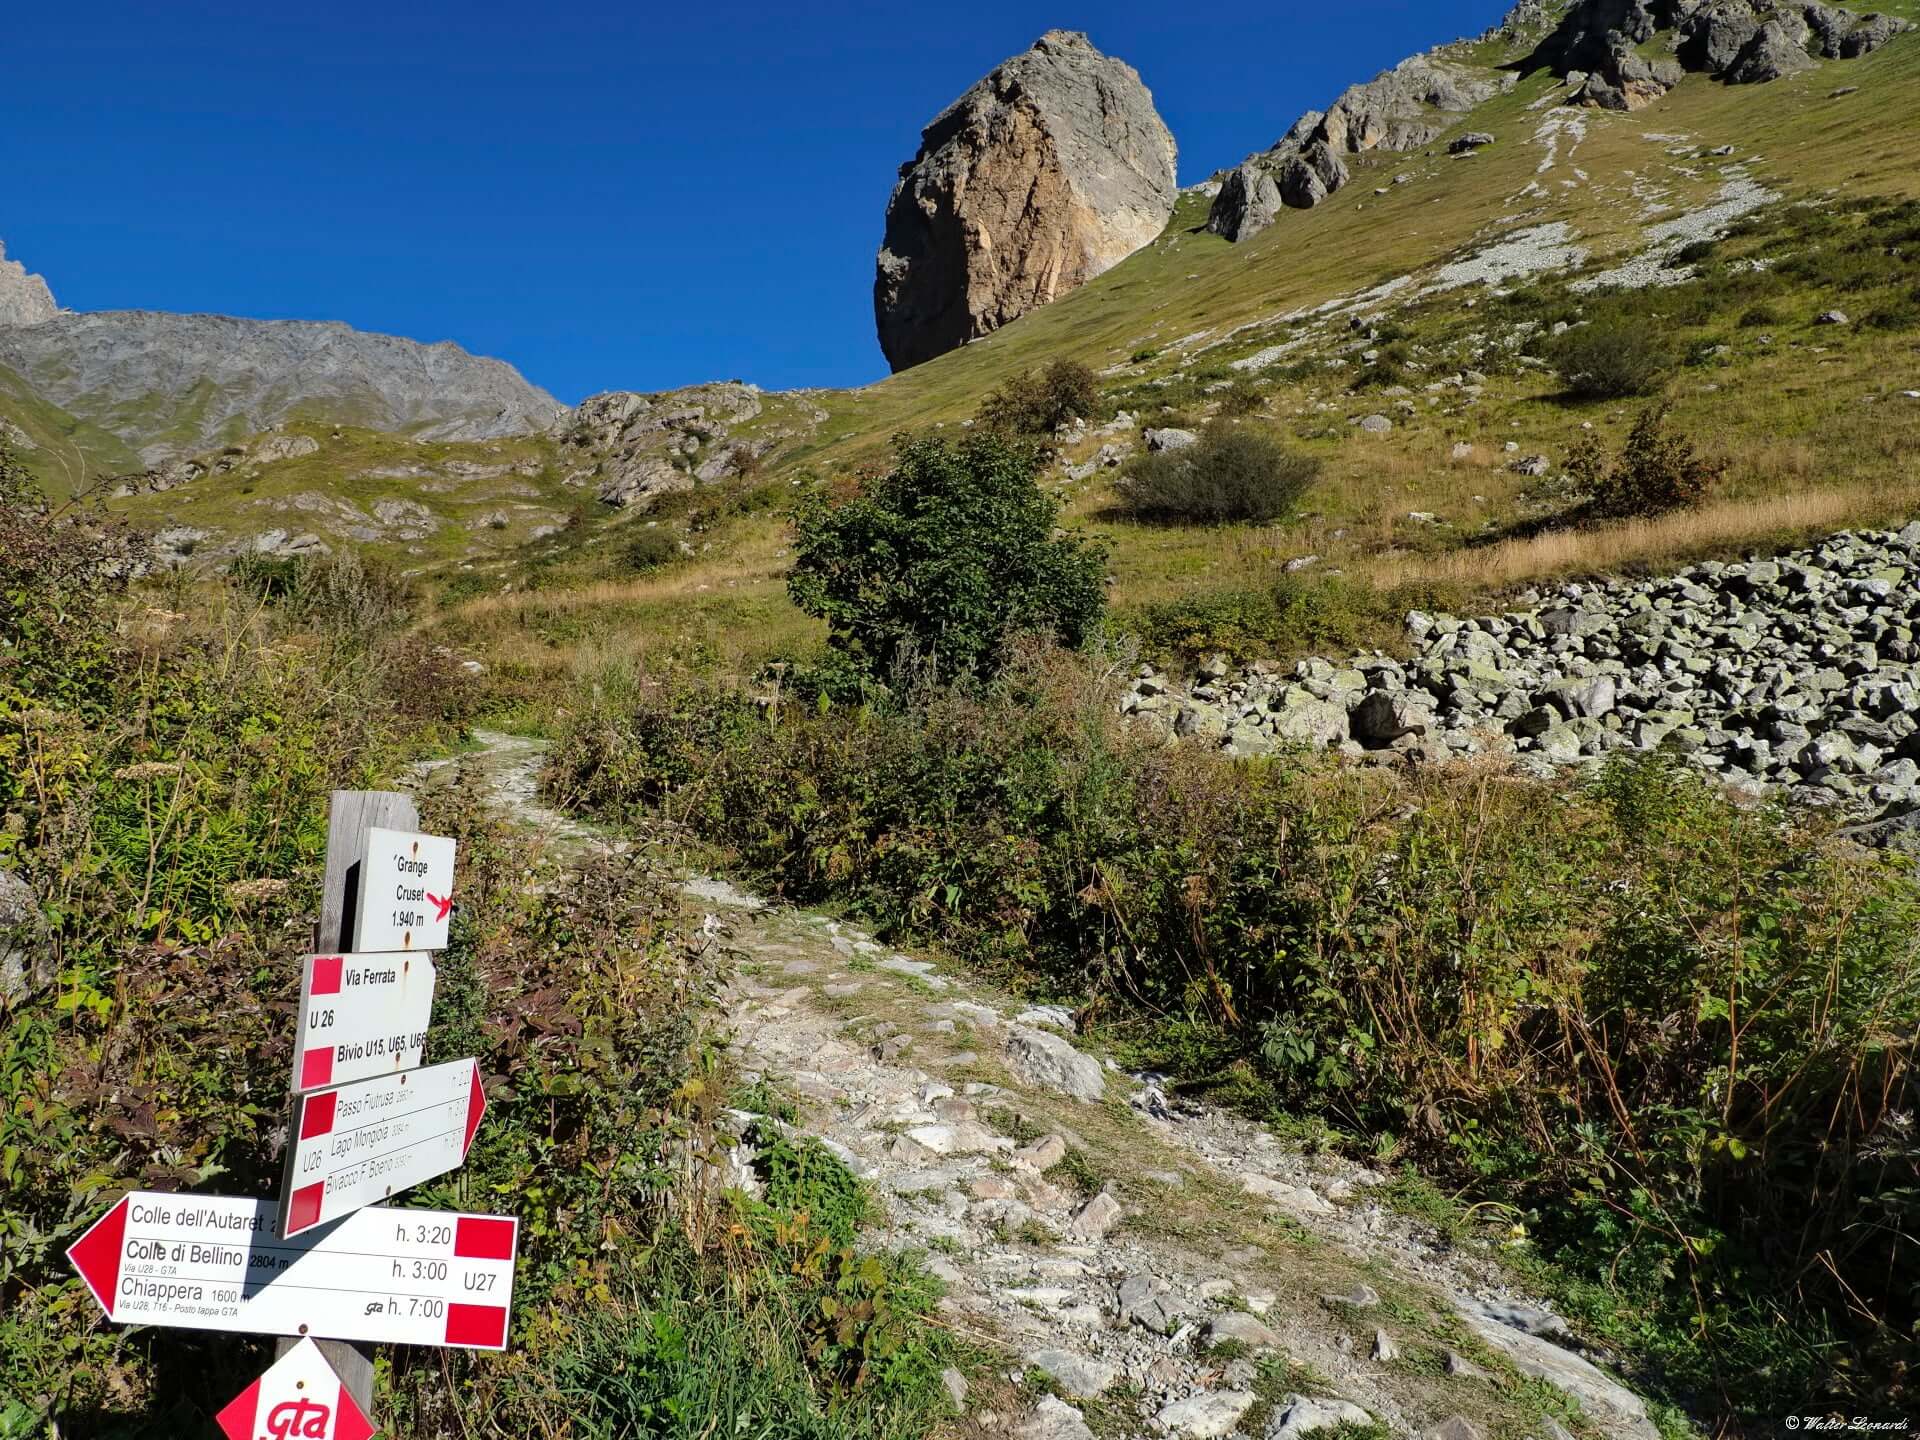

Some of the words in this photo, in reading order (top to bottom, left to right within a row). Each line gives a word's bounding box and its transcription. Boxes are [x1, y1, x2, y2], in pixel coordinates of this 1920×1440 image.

[396, 884, 424, 902] Cruset
[392, 910, 414, 927] 1.940
[415, 915, 424, 927] m
[346, 969, 361, 986] Via
[363, 967, 396, 985] Ferrata
[310, 1011, 319, 1029] U
[321, 1009, 335, 1027] 26
[337, 1042, 363, 1063] Bivio
[365, 1038, 386, 1057] U15,
[388, 1034, 407, 1053] U65,
[336, 1097, 363, 1119] Passo
[330, 1133, 353, 1159] Lago
[303, 1149, 323, 1174] U26
[132, 1204, 171, 1225] Colle
[175, 1208, 264, 1233] dell'Autaret
[396, 1223, 411, 1242] h.
[416, 1224, 451, 1245] 3:20
[127, 1240, 167, 1261] Colle
[171, 1244, 187, 1263] di
[190, 1245, 243, 1267] Bellino
[250, 1255, 276, 1269] 2804
[278, 1259, 289, 1270] m
[124, 1263, 137, 1274] Via
[138, 1264, 154, 1274] U28
[160, 1265, 178, 1275] GTA
[392, 1259, 407, 1278] h.
[412, 1260, 448, 1281] 3:00
[121, 1277, 203, 1301] Chiappera
[211, 1289, 237, 1303] 1600
[240, 1293, 251, 1304] m
[464, 1271, 497, 1292] U27
[119, 1300, 131, 1309] Via
[174, 1304, 196, 1315] Posto
[221, 1306, 239, 1316] GTA
[388, 1297, 402, 1316] h.
[409, 1298, 444, 1319] 7:00
